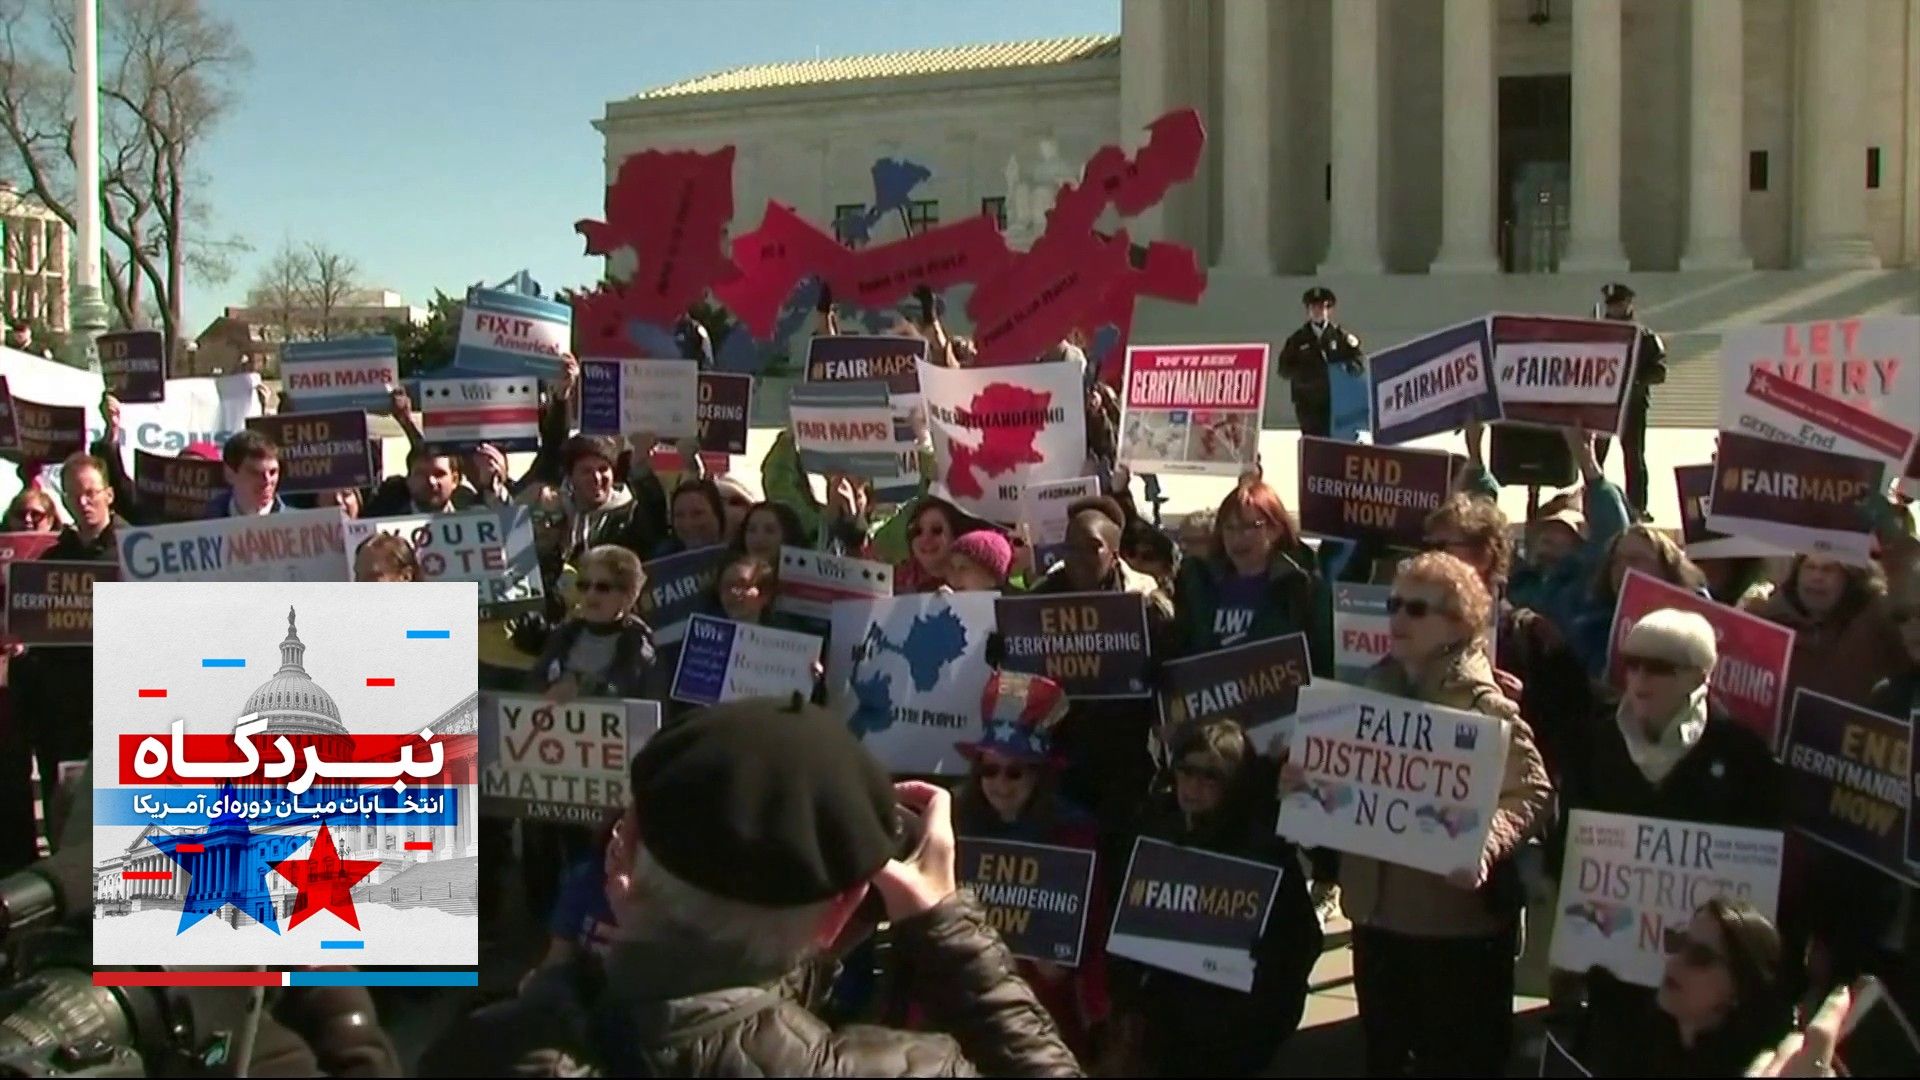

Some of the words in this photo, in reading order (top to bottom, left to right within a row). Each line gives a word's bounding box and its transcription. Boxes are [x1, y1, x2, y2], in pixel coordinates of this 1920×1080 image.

[476, 314, 509, 336] FIX
[514, 319, 533, 338] IT
[1784, 320, 1861, 356] LET
[812, 354, 916, 380] #FAIRMAPS
[1155, 355, 1197, 367] YOU'VE
[1502, 356, 1620, 388] #FAIRMAPS
[289, 371, 332, 390] FAIR
[335, 368, 393, 387] MAPS
[1131, 368, 1256, 405] GERRYMANDERED!
[1384, 352, 1479, 411] #FAIRMAPS
[137, 422, 233, 450] Caus
[282, 421, 330, 443] END
[829, 421, 888, 441] MAPS
[287, 458, 332, 477] NOW
[1345, 455, 1403, 486] END
[1307, 476, 1439, 509] GERRYMANDERING
[1343, 501, 1398, 529] NOW
[122, 532, 223, 579] GERRY
[421, 546, 506, 577] OTE
[1041, 606, 1100, 633] END
[1046, 655, 1101, 678] NOW
[503, 704, 622, 739] YOUR
[1355, 704, 1434, 752] FAIR
[505, 734, 624, 770] VOTE
[1303, 734, 1472, 800] DISTRICTS
[482, 768, 626, 809] MATTER
[527, 803, 604, 822] LWV.ORG
[1634, 824, 1714, 870] FAIR
[976, 853, 1039, 887] END
[1128, 879, 1261, 921] #FAIRMAPS
[985, 908, 1031, 935] OW
